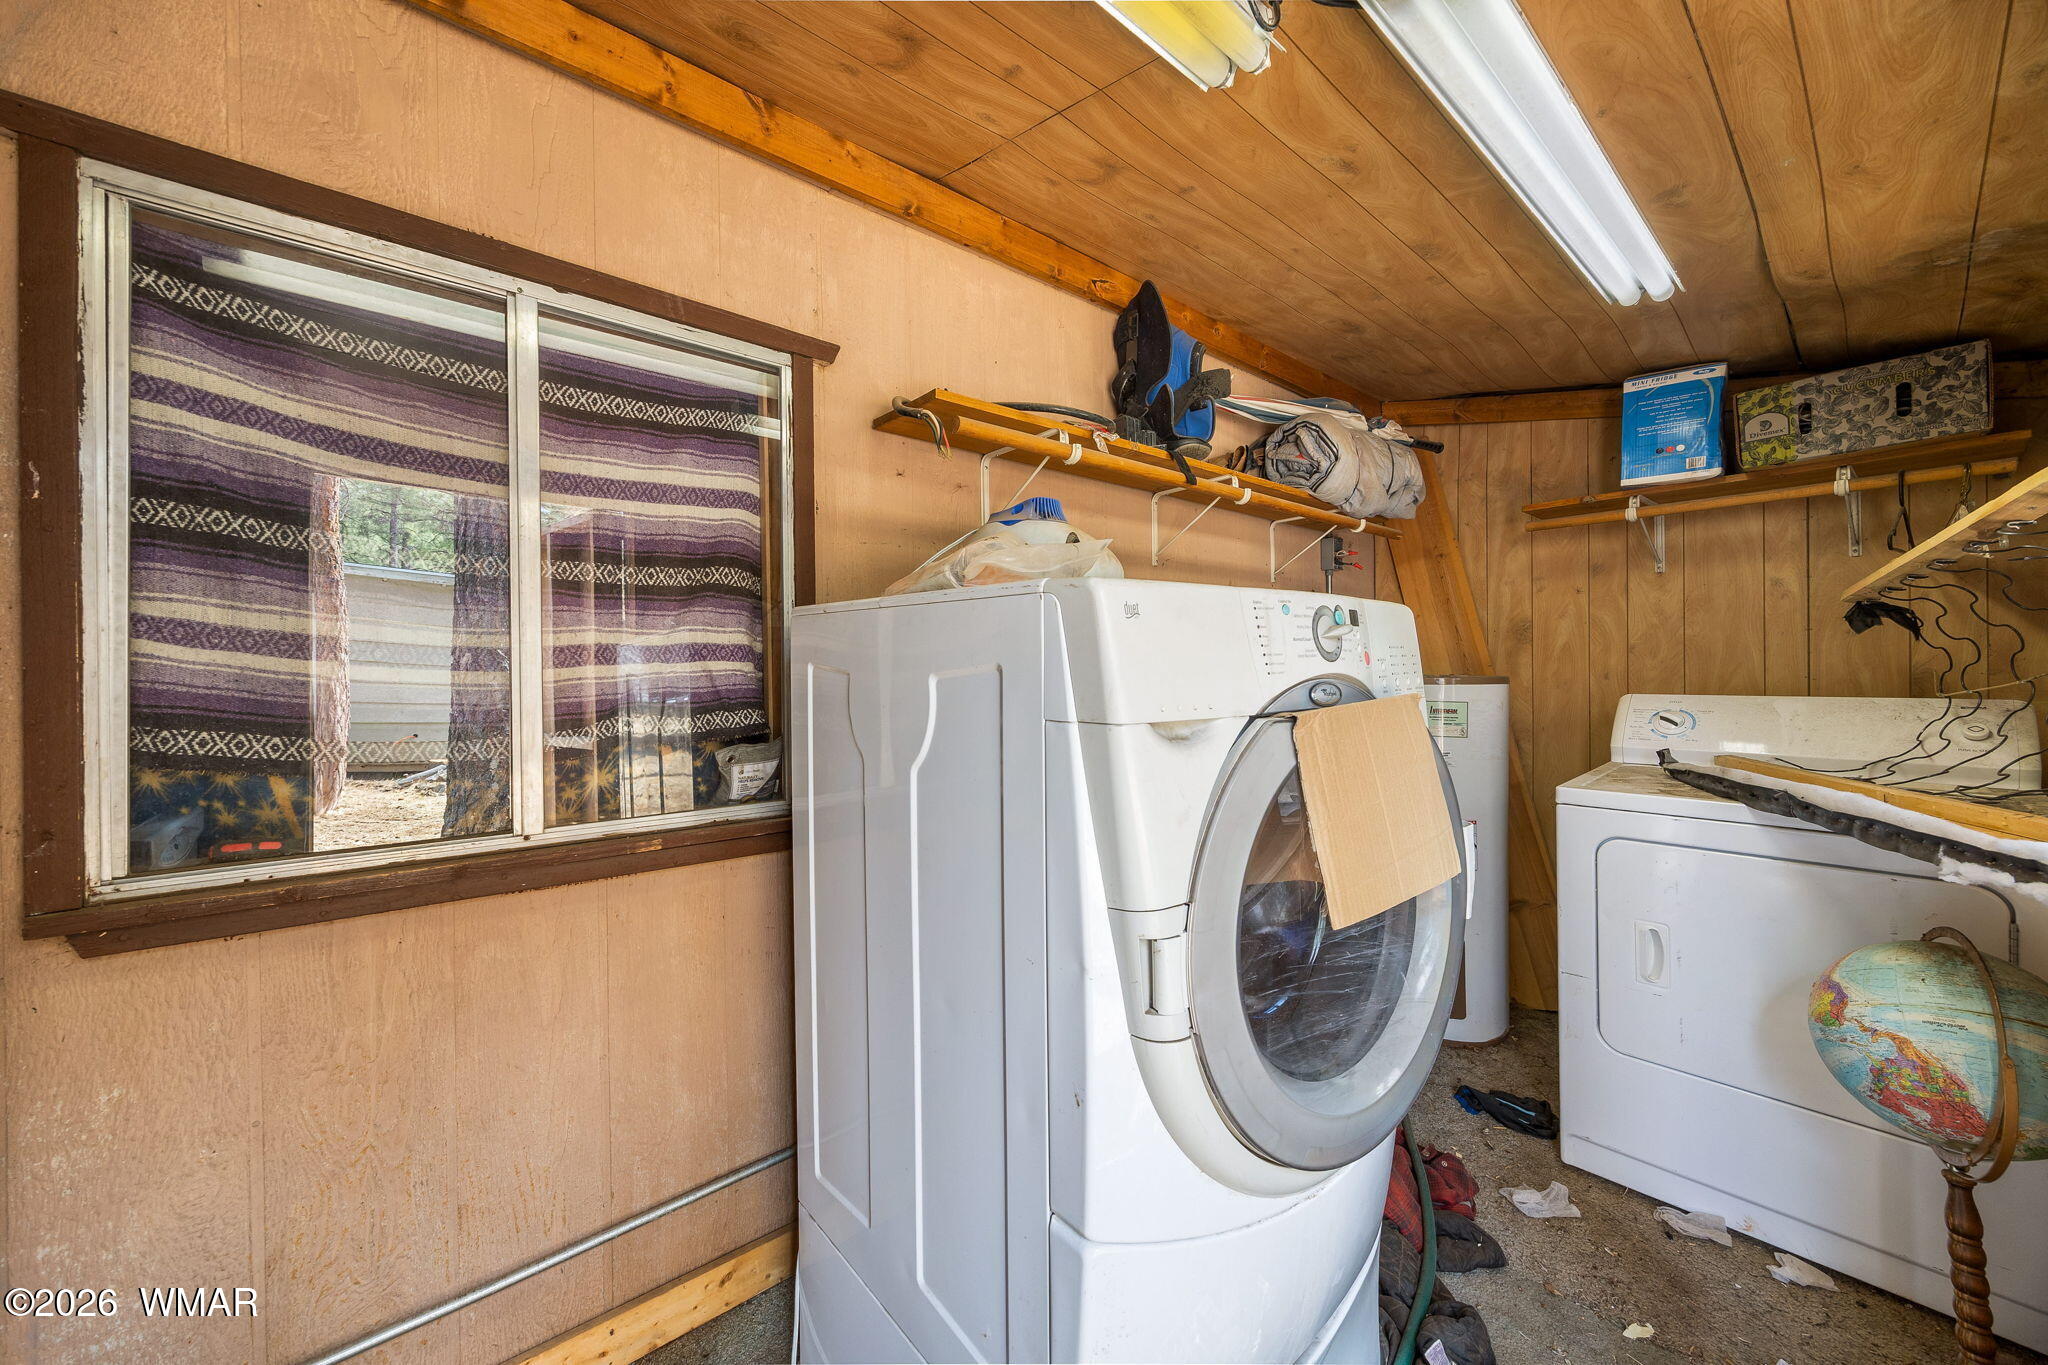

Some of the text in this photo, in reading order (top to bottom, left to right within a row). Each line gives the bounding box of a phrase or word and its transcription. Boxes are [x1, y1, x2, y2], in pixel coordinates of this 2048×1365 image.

[1631, 379, 1650, 387] MINI
[1650, 373, 1678, 384] FRIDGE
[1831, 366, 1937, 396] CUCUMBERS
